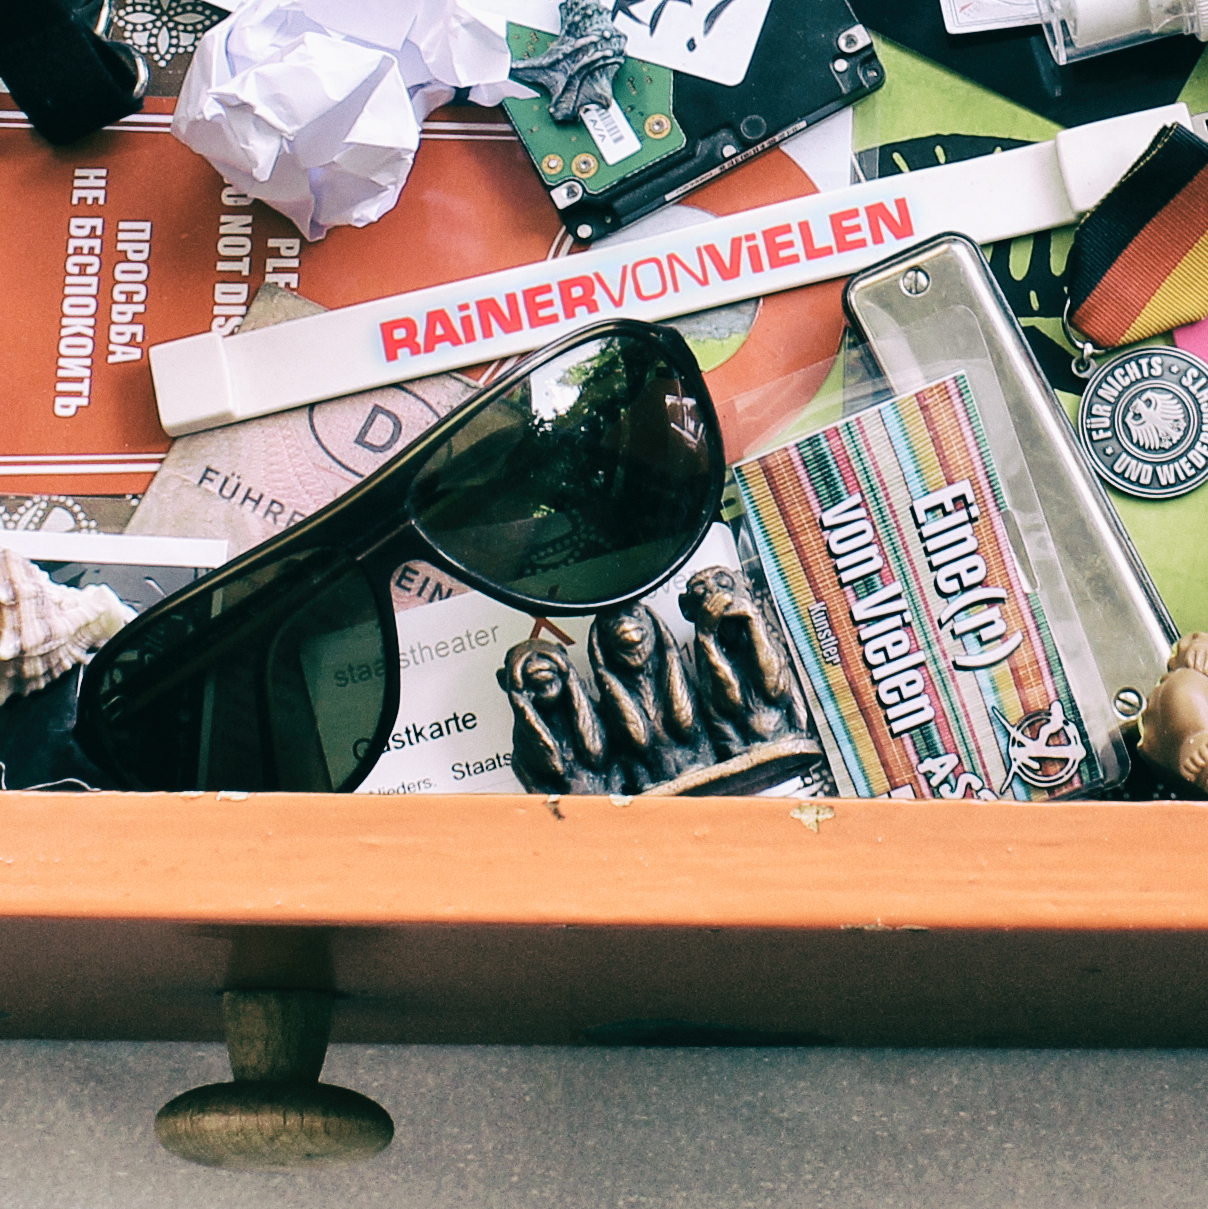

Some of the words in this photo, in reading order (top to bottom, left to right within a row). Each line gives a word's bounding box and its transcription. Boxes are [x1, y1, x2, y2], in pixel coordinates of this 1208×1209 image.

[69, 166, 107, 207] НЕ
[214, 214, 254, 277] NOT
[53, 216, 104, 419] БЕСПОКОИТЬ
[106, 219, 153, 365] ПРОСЬБА
[210, 281, 247, 337] DIS
[1096, 355, 1164, 404] NICHTS
[352, 403, 403, 455] D
[1085, 403, 1113, 442] FÜR
[1112, 451, 1154, 486] UND
[819, 492, 884, 584] von
[393, 567, 455, 603] EIN
[911, 478, 1025, 674] Eine(r)
[333, 623, 499, 688] staastheater
[849, 582, 936, 739] Vielen
